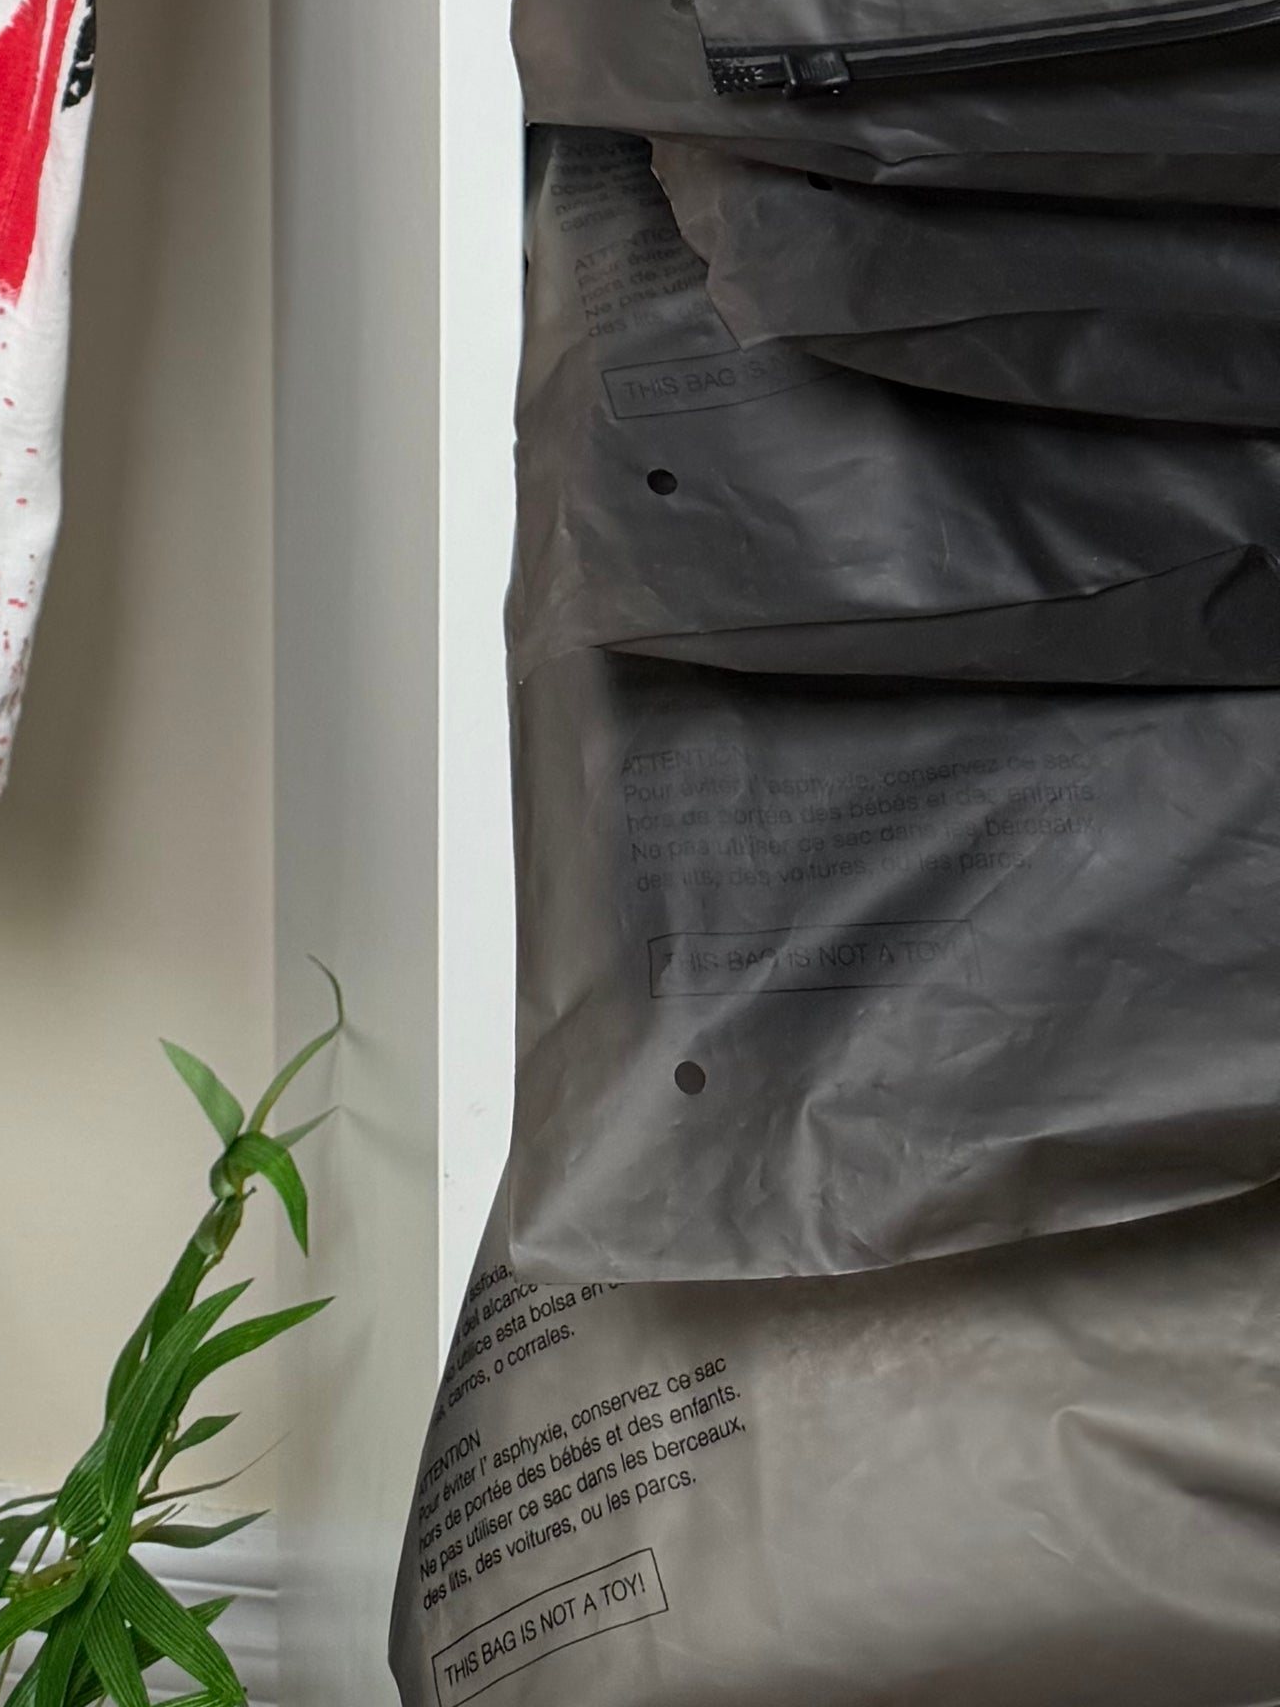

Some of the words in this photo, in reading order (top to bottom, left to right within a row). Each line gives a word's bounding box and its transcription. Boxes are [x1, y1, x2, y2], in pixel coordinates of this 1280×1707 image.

[621, 376, 680, 400] THIS
[683, 366, 737, 392] BAG
[818, 943, 868, 967] NOT
[875, 944, 897, 965] A
[493, 1357, 505, 1376] o
[505, 1323, 576, 1367] corrales.
[494, 1315, 527, 1344] esta
[528, 1290, 578, 1324] bolsa
[579, 1283, 606, 1304] en
[442, 1466, 477, 1502] éviter
[492, 1423, 569, 1469] asphyxie,
[570, 1380, 662, 1430] conservez
[665, 1372, 693, 1394] ce
[693, 1356, 727, 1384] sac
[444, 1506, 462, 1531] de
[463, 1478, 514, 1523] portée
[515, 1462, 547, 1489] des
[549, 1435, 602, 1474] bébés
[605, 1424, 624, 1447] et
[626, 1412, 665, 1438] des
[669, 1384, 743, 1425] enfants.
[419, 1557, 439, 1583] Ne
[439, 1538, 464, 1572] pas
[465, 1509, 514, 1548] utiliser
[517, 1498, 540, 1523] ce
[541, 1483, 573, 1510] sac
[575, 1461, 619, 1494] dans
[619, 1448, 649, 1474] les
[651, 1415, 748, 1462] berceaux,
[422, 1582, 448, 1612] des
[447, 1567, 473, 1594] lits,
[474, 1547, 503, 1576] des
[504, 1516, 578, 1559] voitures,
[579, 1502, 604, 1526] ou
[604, 1486, 631, 1515] les
[633, 1468, 697, 1505] parcs.
[442, 1653, 481, 1688] THIS
[479, 1629, 518, 1667] BAG
[519, 1618, 539, 1646] IS
[539, 1596, 577, 1635] NOT
[581, 1590, 599, 1617] A
[597, 1570, 648, 1608] TOY!
